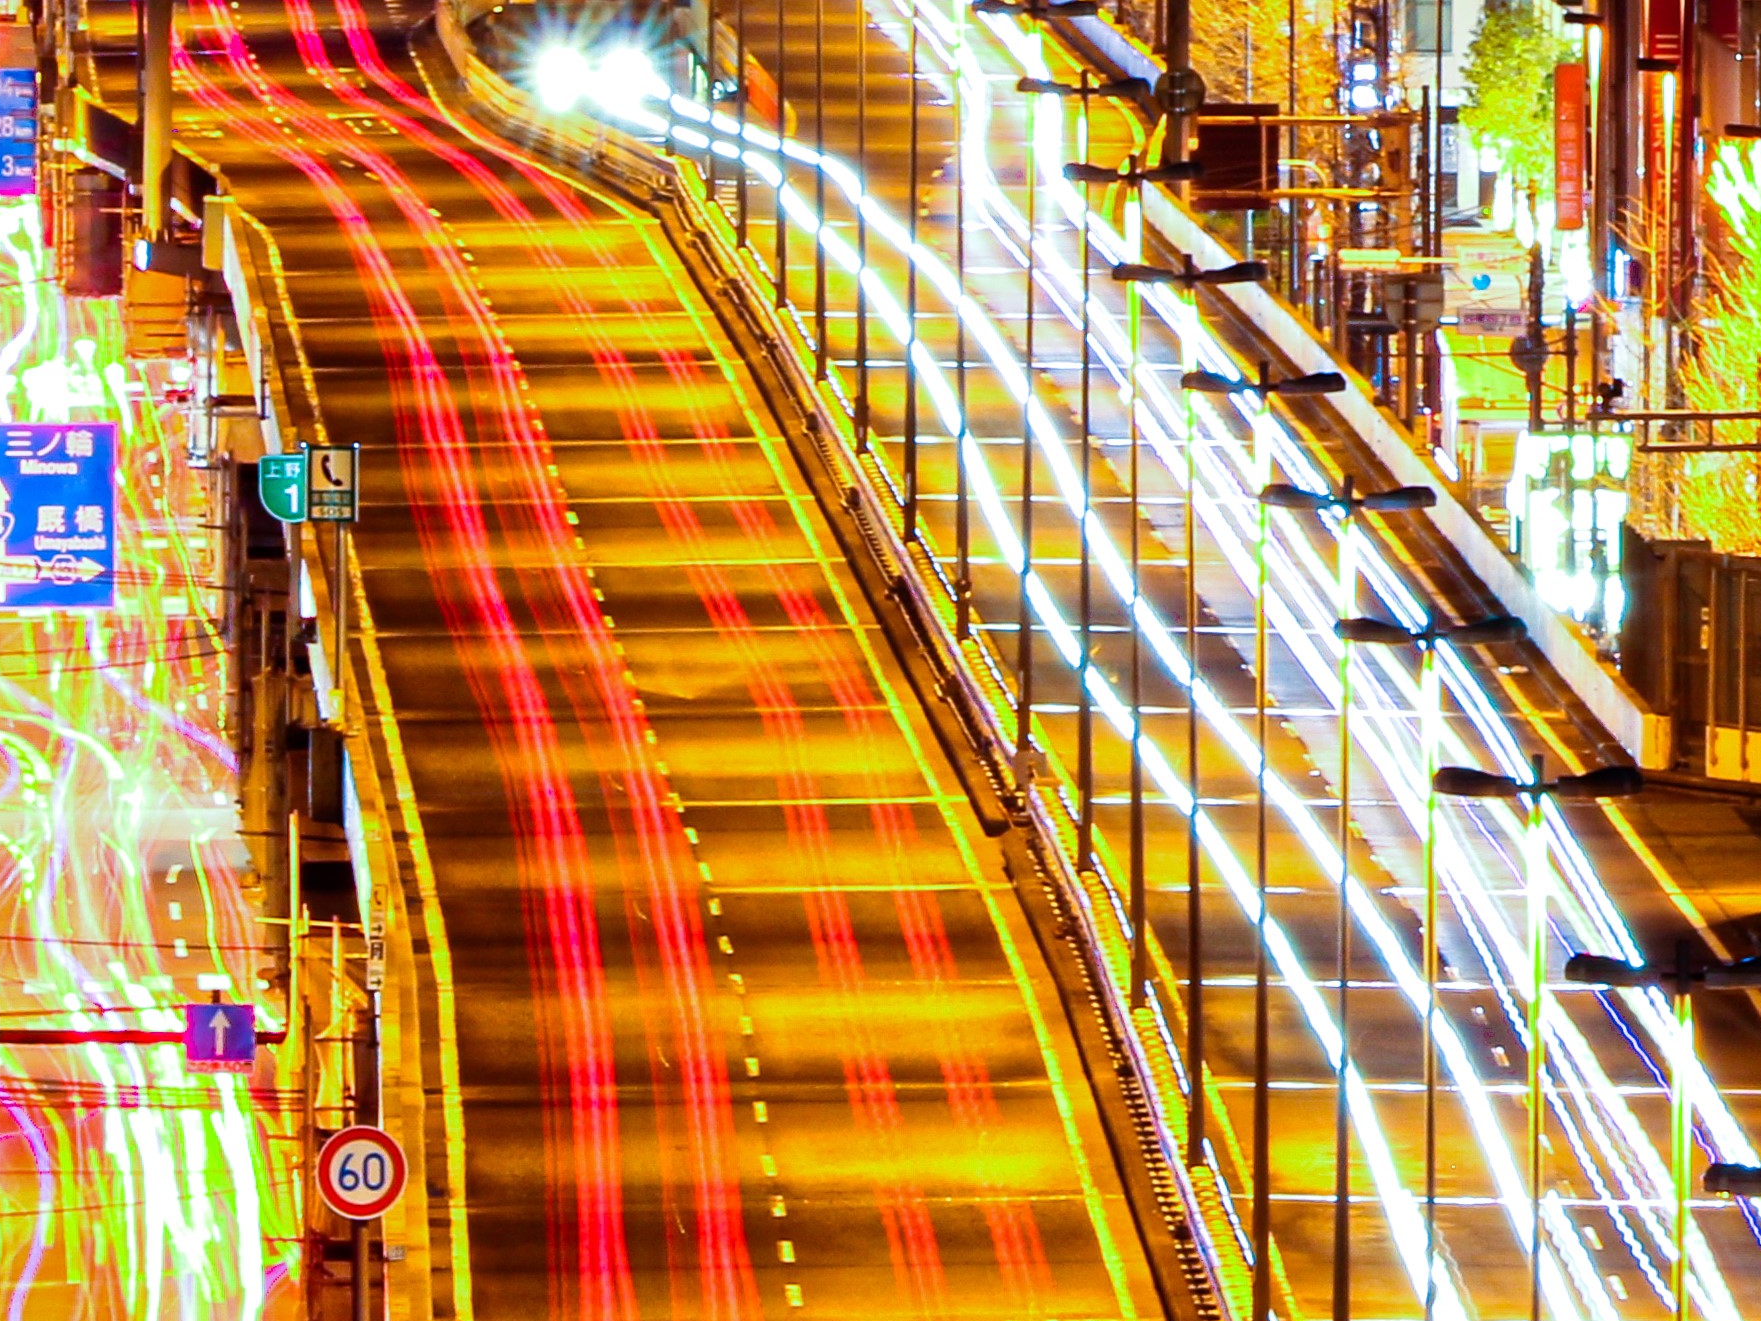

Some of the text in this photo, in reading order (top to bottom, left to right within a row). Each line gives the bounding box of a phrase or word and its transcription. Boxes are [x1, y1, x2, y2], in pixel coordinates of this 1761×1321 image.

[4, 429, 94, 458] 三ノ輪
[19, 459, 78, 476] Minowa
[264, 460, 301, 479] 上野
[283, 483, 300, 514] 1
[338, 1152, 387, 1192] 60
